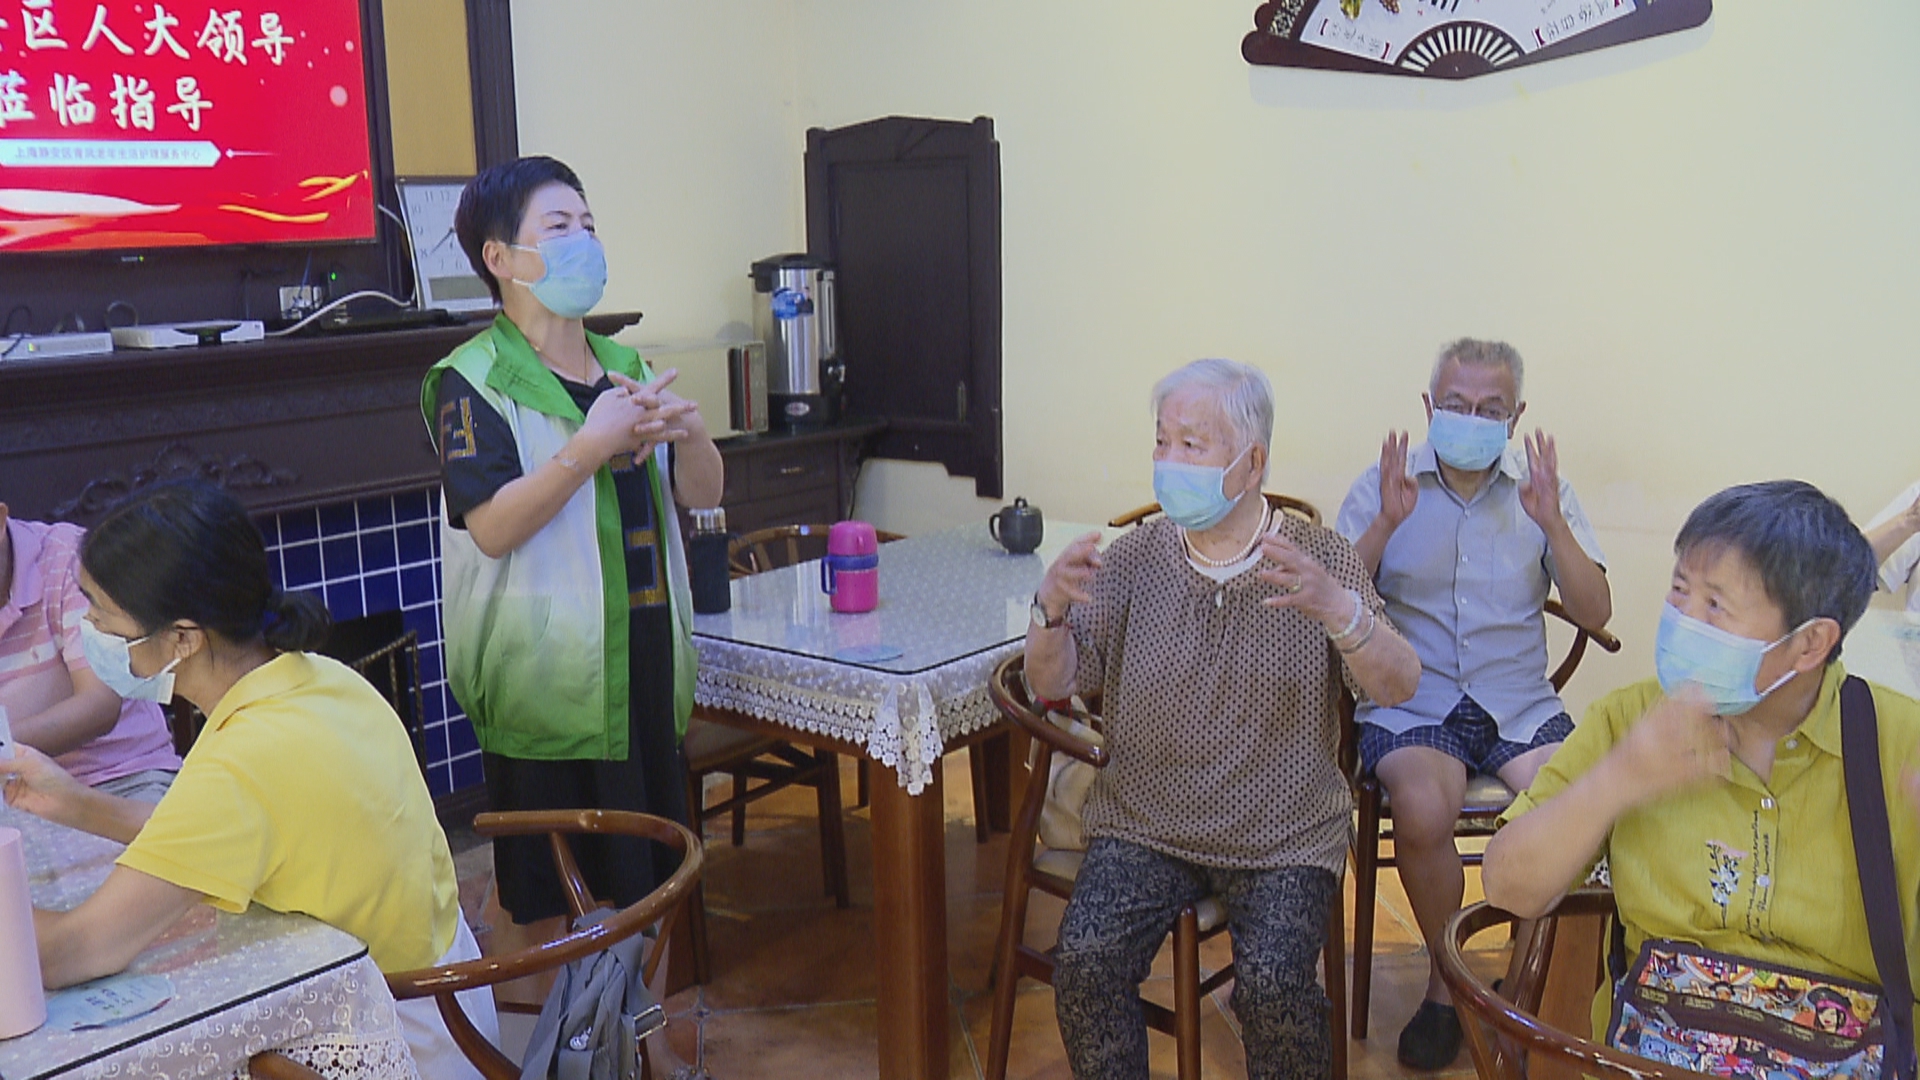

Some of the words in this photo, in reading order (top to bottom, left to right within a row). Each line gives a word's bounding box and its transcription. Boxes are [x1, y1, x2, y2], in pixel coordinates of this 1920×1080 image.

[0, 0, 295, 66] 区人大领导
[0, 68, 213, 131] 莅临指导
